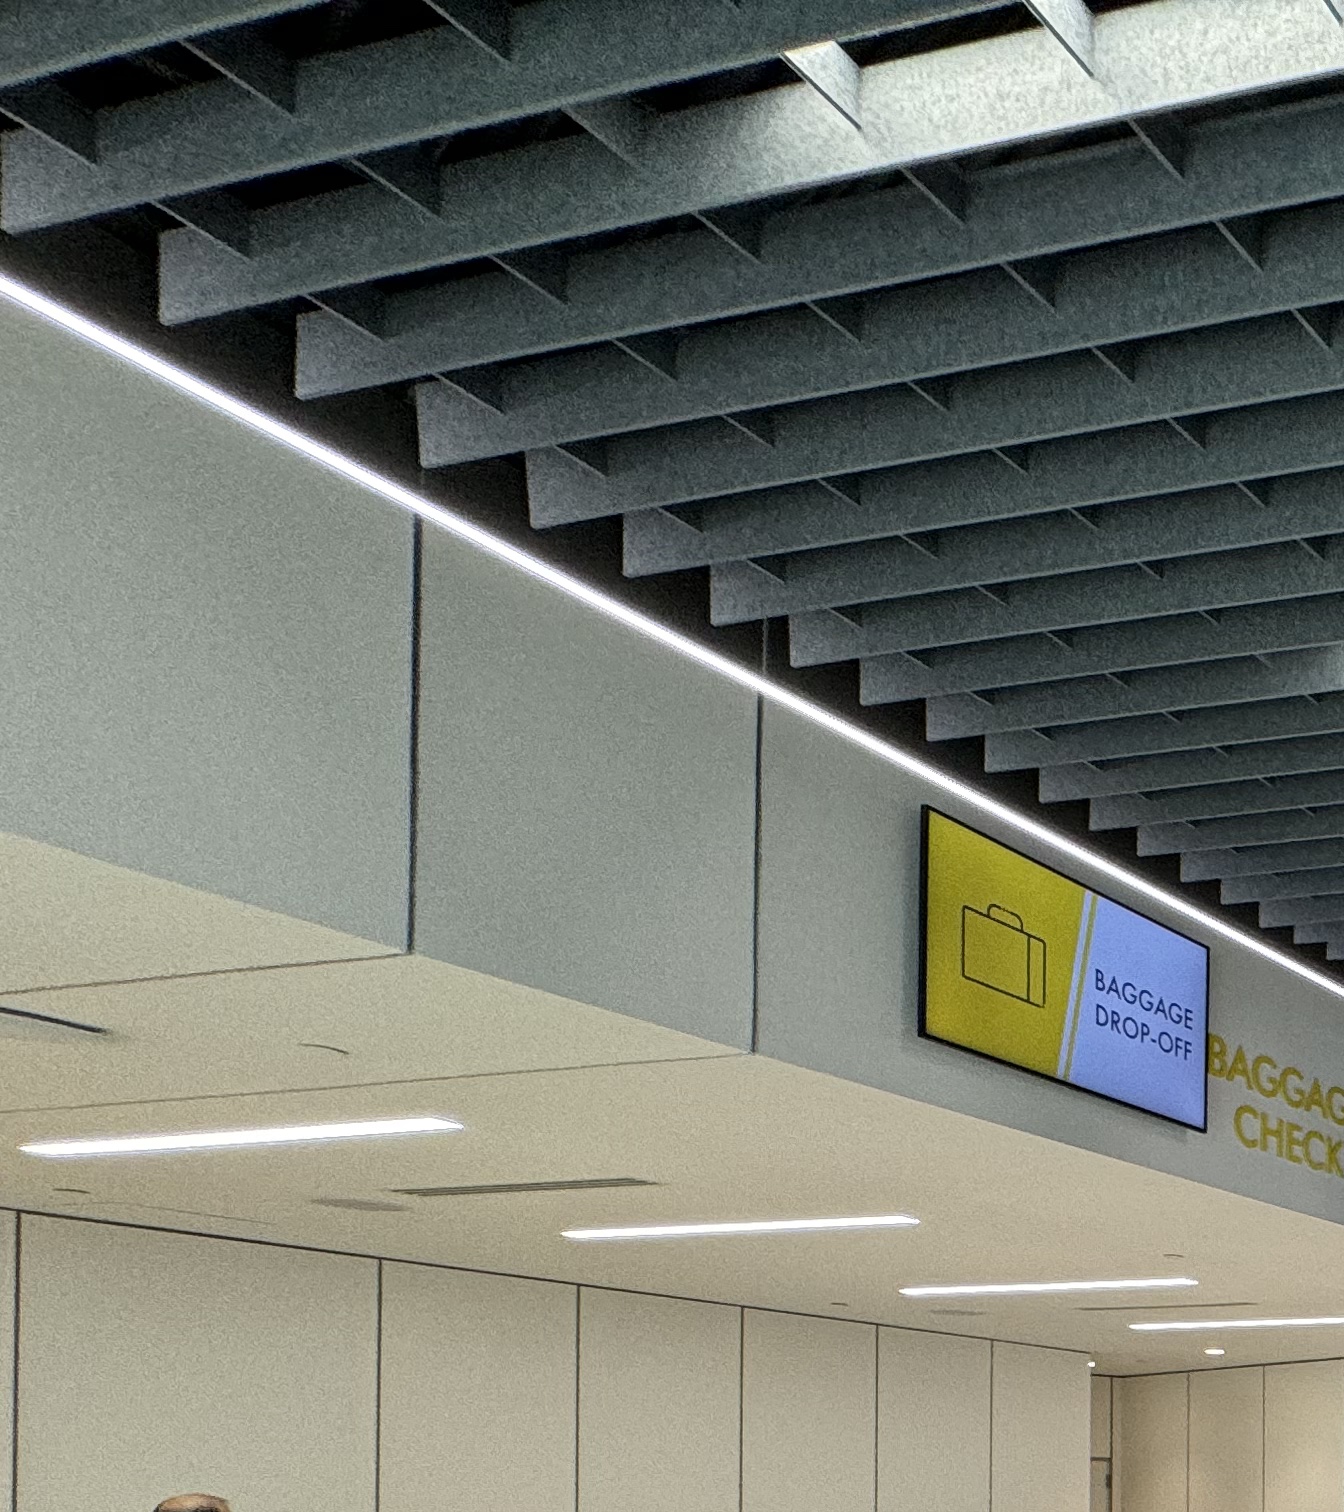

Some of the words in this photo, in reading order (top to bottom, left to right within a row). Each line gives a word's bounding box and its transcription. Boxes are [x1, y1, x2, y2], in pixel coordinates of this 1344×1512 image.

[1094, 967, 1194, 1031] BAGGAGE
[1095, 1003, 1193, 1061] DROP-OFF
[1233, 1104, 1344, 1179] CHECK
